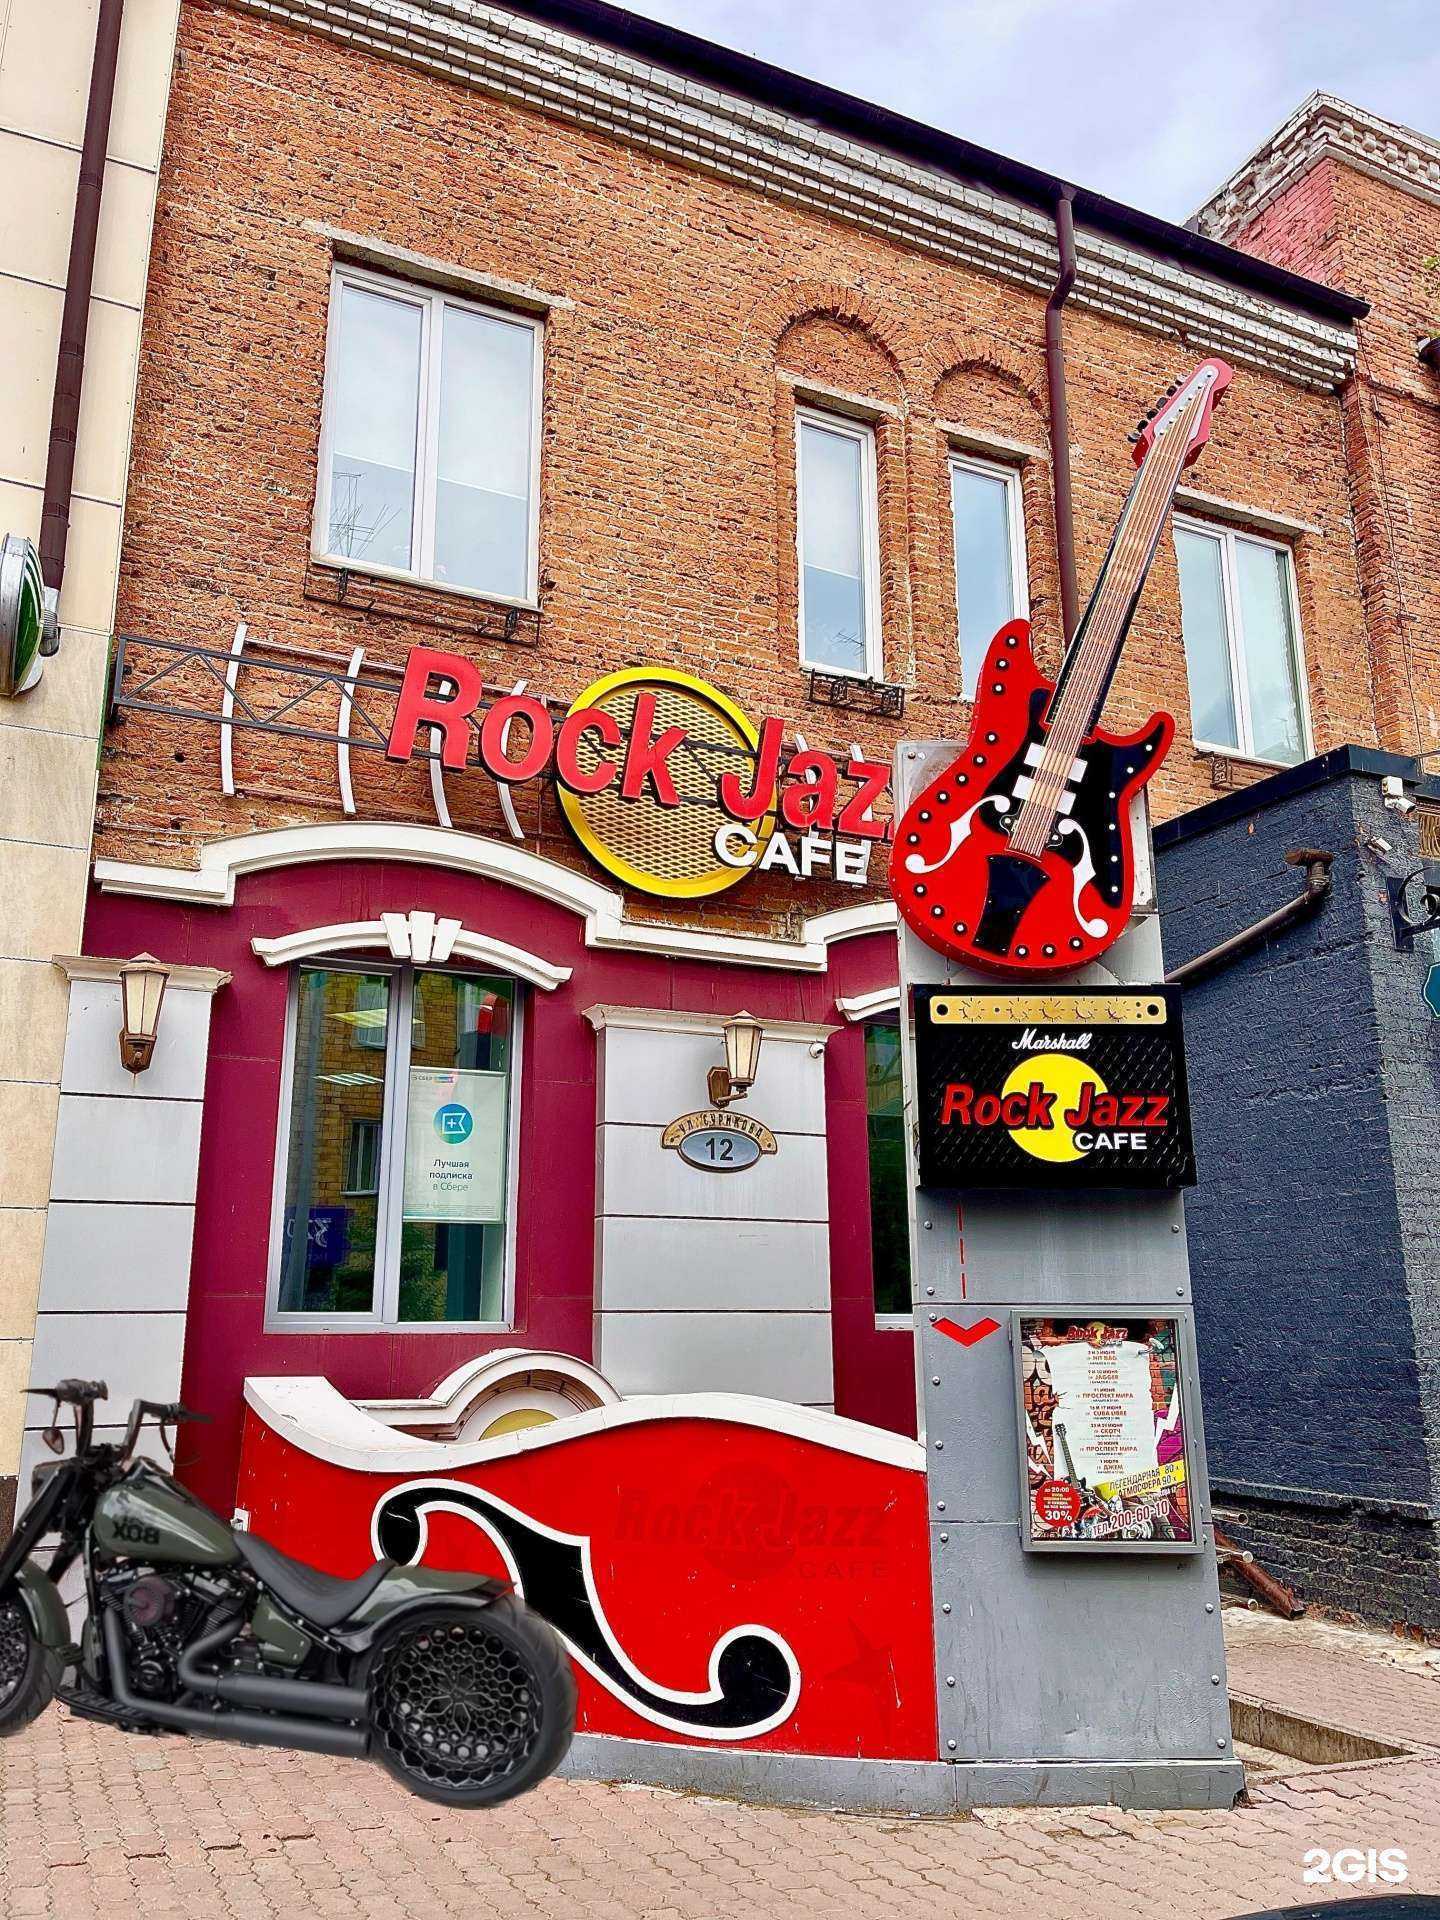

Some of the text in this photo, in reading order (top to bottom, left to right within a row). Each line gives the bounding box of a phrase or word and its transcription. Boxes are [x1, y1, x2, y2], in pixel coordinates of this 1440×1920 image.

[385, 646, 894, 841] Rock Jaz
[714, 822, 870, 885] CAFE
[1011, 1028, 1093, 1050] Marshall
[939, 1082, 1170, 1127] Rock Jazz
[705, 1137, 734, 1161] 12
[1075, 1132, 1148, 1150] CAFE
[433, 1158, 470, 1168] Лучшая
[429, 1171, 473, 1180] подписка
[440, 1181, 470, 1192] Сбере
[1109, 1468, 1160, 1491] ЛЕГЕНДАРНАЯ
[1118, 1479, 1161, 1498] АТМОСФЕРА
[1044, 1510, 1073, 1521] 30%
[1110, 1499, 1169, 1530] 200-60-10
